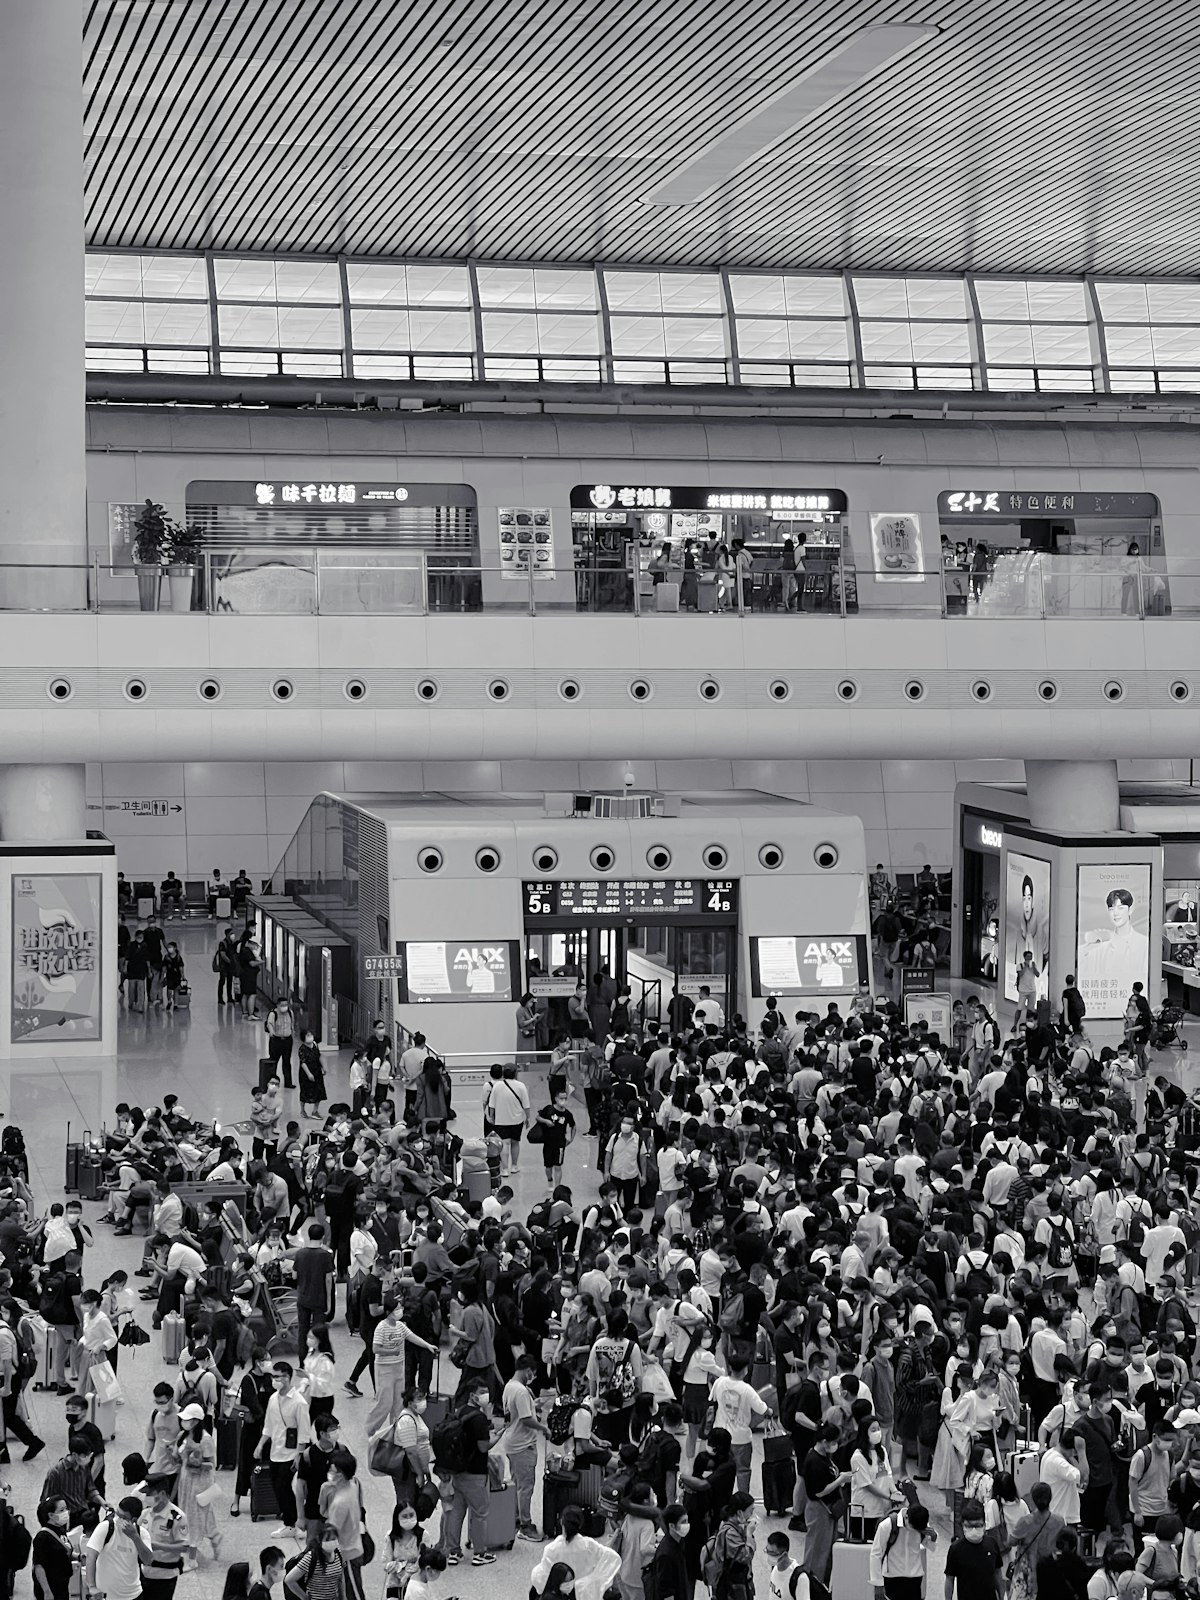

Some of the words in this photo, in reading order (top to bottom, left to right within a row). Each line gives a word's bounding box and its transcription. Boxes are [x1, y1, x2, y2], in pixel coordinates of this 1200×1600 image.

[618, 488, 671, 506] 老娘舅
[1010, 495, 1074, 509] 特色便利
[121, 800, 151, 811] 卫生间
[527, 883, 553, 891] 检票口
[707, 881, 733, 889] 检票口
[1081, 979, 1119, 989] 眼睛疲劳
